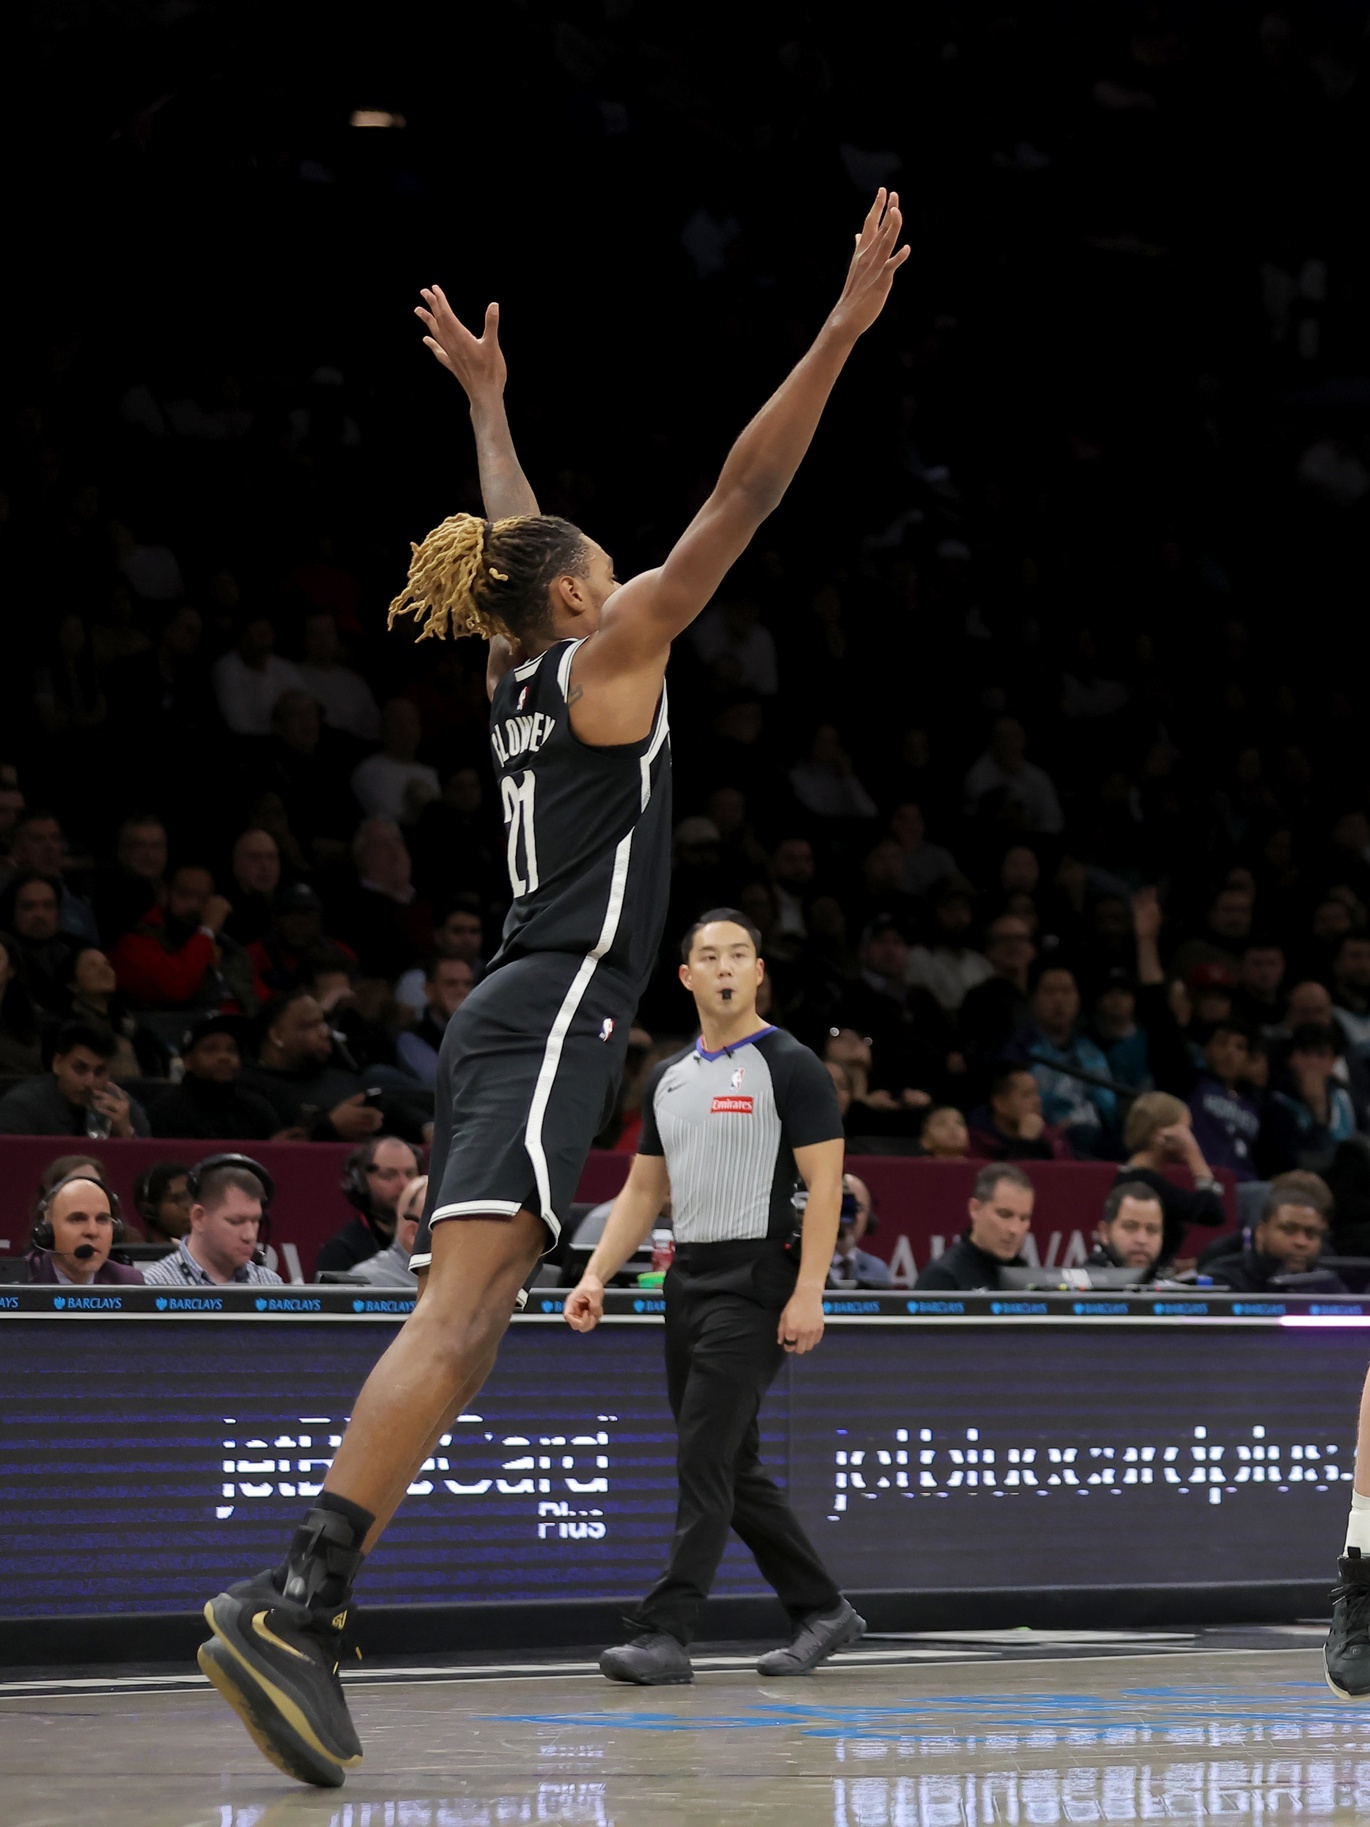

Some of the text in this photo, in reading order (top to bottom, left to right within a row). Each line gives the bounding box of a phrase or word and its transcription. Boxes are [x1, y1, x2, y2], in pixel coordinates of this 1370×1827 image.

[501, 769, 540, 898] 21
[712, 1099, 753, 1110] Emirates
[67, 1297, 122, 1309] BARCLAYS
[169, 1297, 223, 1310] BARCLAYS
[268, 1298, 321, 1311] BARCLAYS
